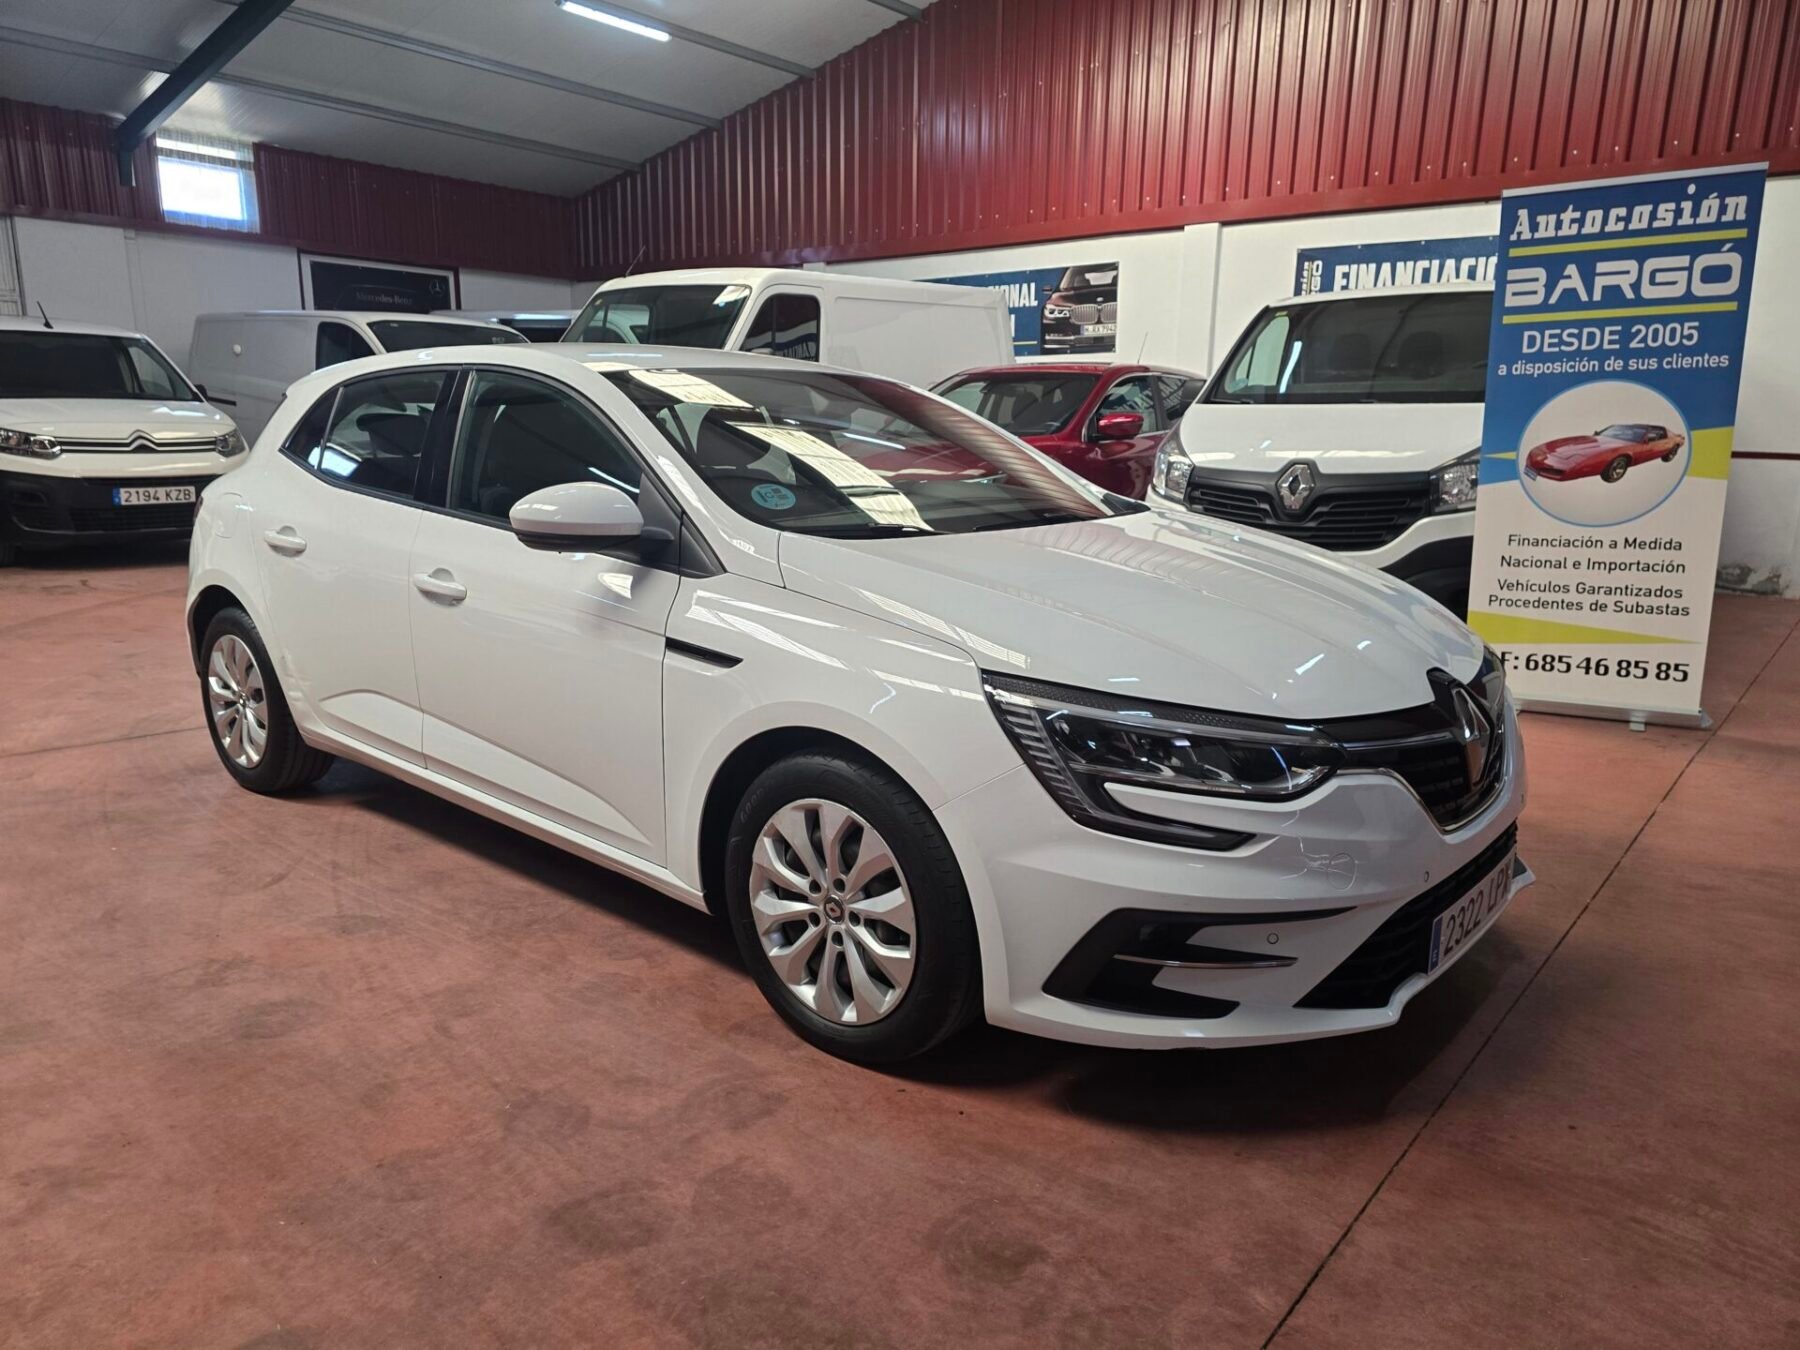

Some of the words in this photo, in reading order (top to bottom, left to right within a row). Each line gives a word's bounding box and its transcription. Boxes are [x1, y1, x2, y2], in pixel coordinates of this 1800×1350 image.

[1510, 184, 1748, 241] Autocasión
[1504, 243, 1743, 307] BARGÓ
[1522, 326, 1622, 353] DESDE
[1630, 322, 1699, 349] 2005
[1498, 365, 1507, 376] a
[1512, 357, 1599, 378] disposición
[1604, 357, 1624, 371] de
[1628, 359, 1658, 371] sus
[1663, 353, 1729, 369] clientes
[124, 490, 160, 502] 2194
[165, 489, 191, 501] KZB
[1507, 534, 1604, 549] Financiación
[1608, 540, 1618, 550] a
[1623, 537, 1683, 551] Medida
[1500, 555, 1567, 570] Nacional
[1572, 561, 1582, 570] e
[1586, 557, 1686, 574] Importación
[1497, 578, 1570, 594] Vehículos
[1575, 582, 1683, 599] Garantizados
[1488, 595, 1584, 611] Procedentes
[1589, 600, 1608, 613] de
[1612, 600, 1690, 617] Subastas
[1444, 890, 1484, 957] 2322
